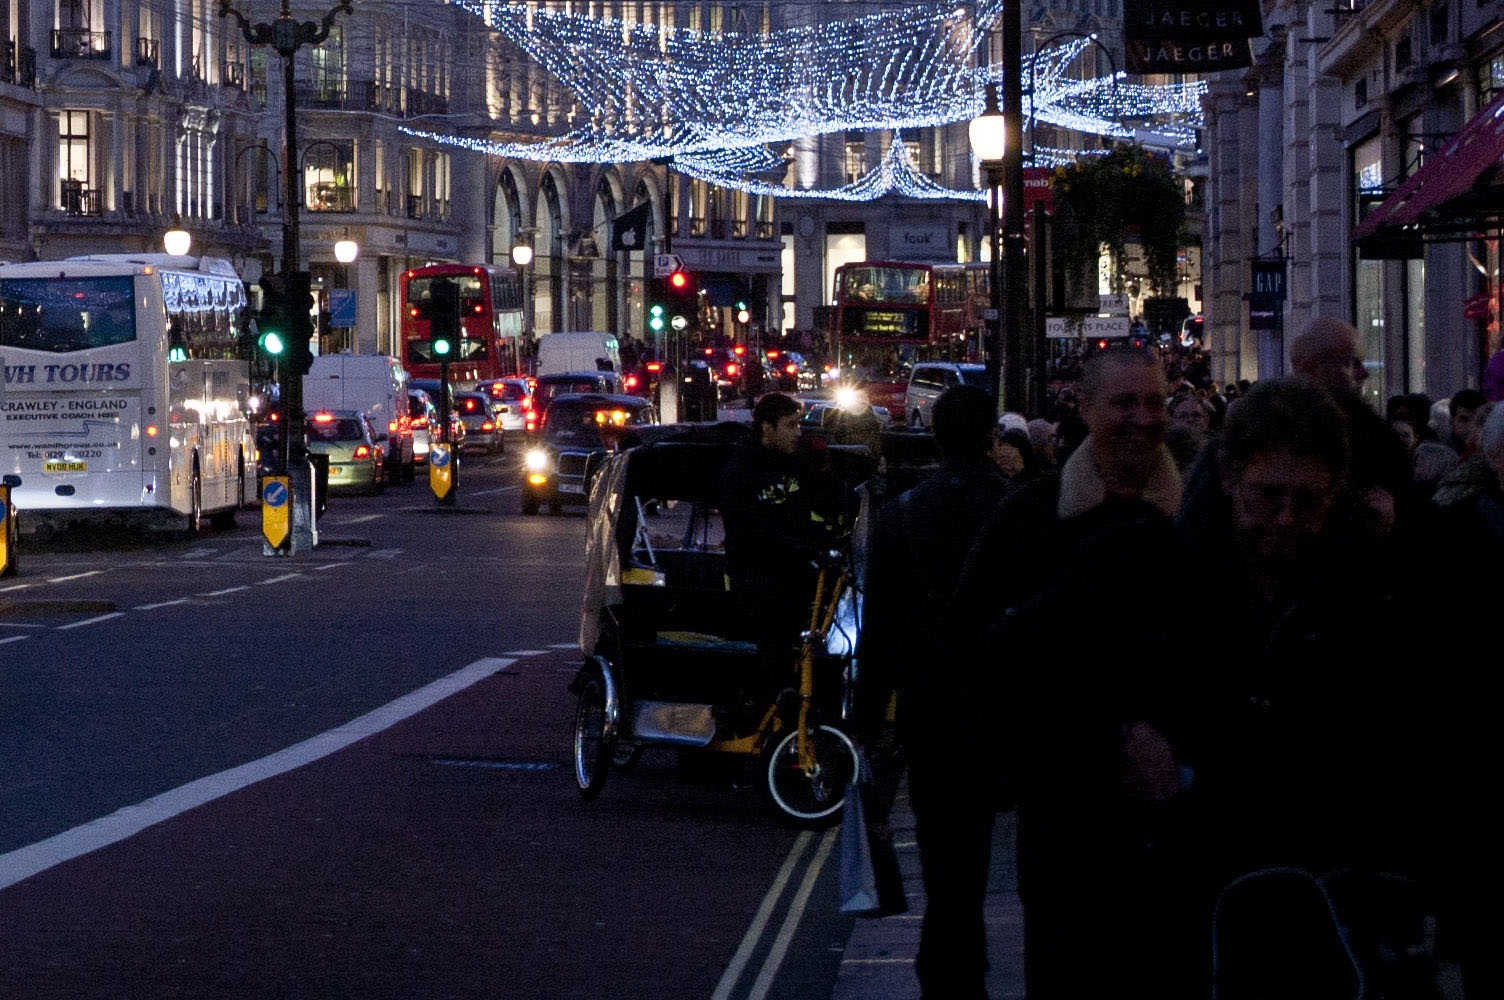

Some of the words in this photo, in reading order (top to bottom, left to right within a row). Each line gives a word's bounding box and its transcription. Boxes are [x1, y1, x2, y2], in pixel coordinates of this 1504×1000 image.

[1146, 10, 1244, 28] JAEGER
[1143, 41, 1234, 63] JAEGER
[1256, 272, 1281, 293] GAP
[44, 363, 131, 384] TOURS
[0, 401, 58, 412] CRAWLEY
[68, 400, 128, 411] ENGLAND
[6, 412, 58, 421] EXECUTIVE
[61, 411, 95, 420] COACH
